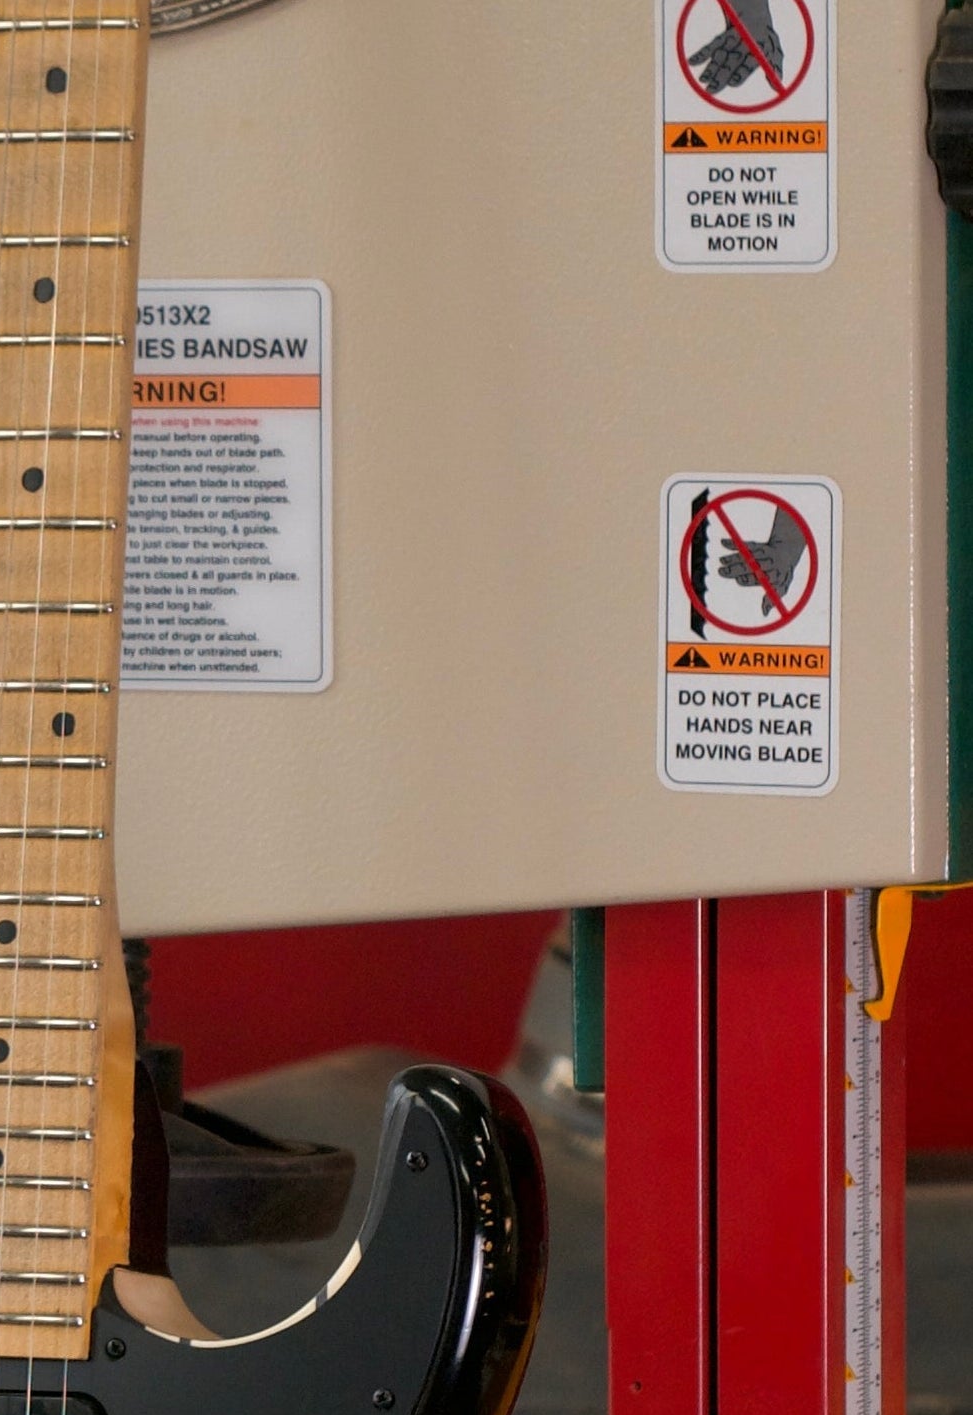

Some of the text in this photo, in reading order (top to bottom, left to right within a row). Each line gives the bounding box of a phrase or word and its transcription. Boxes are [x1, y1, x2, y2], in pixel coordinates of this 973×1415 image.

[717, 129, 821, 145] WARNING!
[708, 167, 777, 182] DO NOT
[687, 190, 798, 206] OPEN WHILE
[690, 213, 795, 228] BLADE IS IN
[708, 236, 778, 251] MOTION
[184, 338, 308, 359] BANDSAW
[133, 432, 170, 442] manual
[174, 432, 206, 442] before
[161, 448, 192, 457] hands
[196, 448, 212, 457] out
[215, 448, 226, 457] of
[229, 448, 257, 457] blade
[184, 464, 203, 473] and
[133, 478, 166, 489] pieces
[169, 478, 197, 488] when
[200, 478, 228, 488] blade
[231, 479, 240, 488] is
[138, 493, 148, 503] to
[152, 493, 167, 503] cut
[171, 493, 198, 503] small
[202, 495, 211, 503] or
[215, 495, 251, 504] narrow
[170, 509, 204, 519] blades
[208, 511, 219, 519] or
[129, 540, 140, 549] to
[193, 540, 209, 549] the
[144, 554, 169, 564] table
[172, 555, 182, 565] to
[185, 555, 230, 565] maintain
[154, 570, 189, 580] closed
[202, 570, 215, 580] all
[218, 571, 253, 583] guards
[256, 571, 266, 580] in
[144, 585, 172, 595] blade
[145, 601, 164, 610] and
[167, 601, 190, 613] long
[157, 616, 175, 625] wet
[158, 631, 169, 641] of
[172, 631, 201, 643] drugs
[139, 647, 180, 656] children
[198, 647, 247, 657] untrained
[719, 652, 824, 669] WARNING!
[679, 690, 822, 709] DO NOT PLACE
[686, 717, 812, 735] HANDS NEAR
[675, 744, 823, 763] MOVING BLADE
